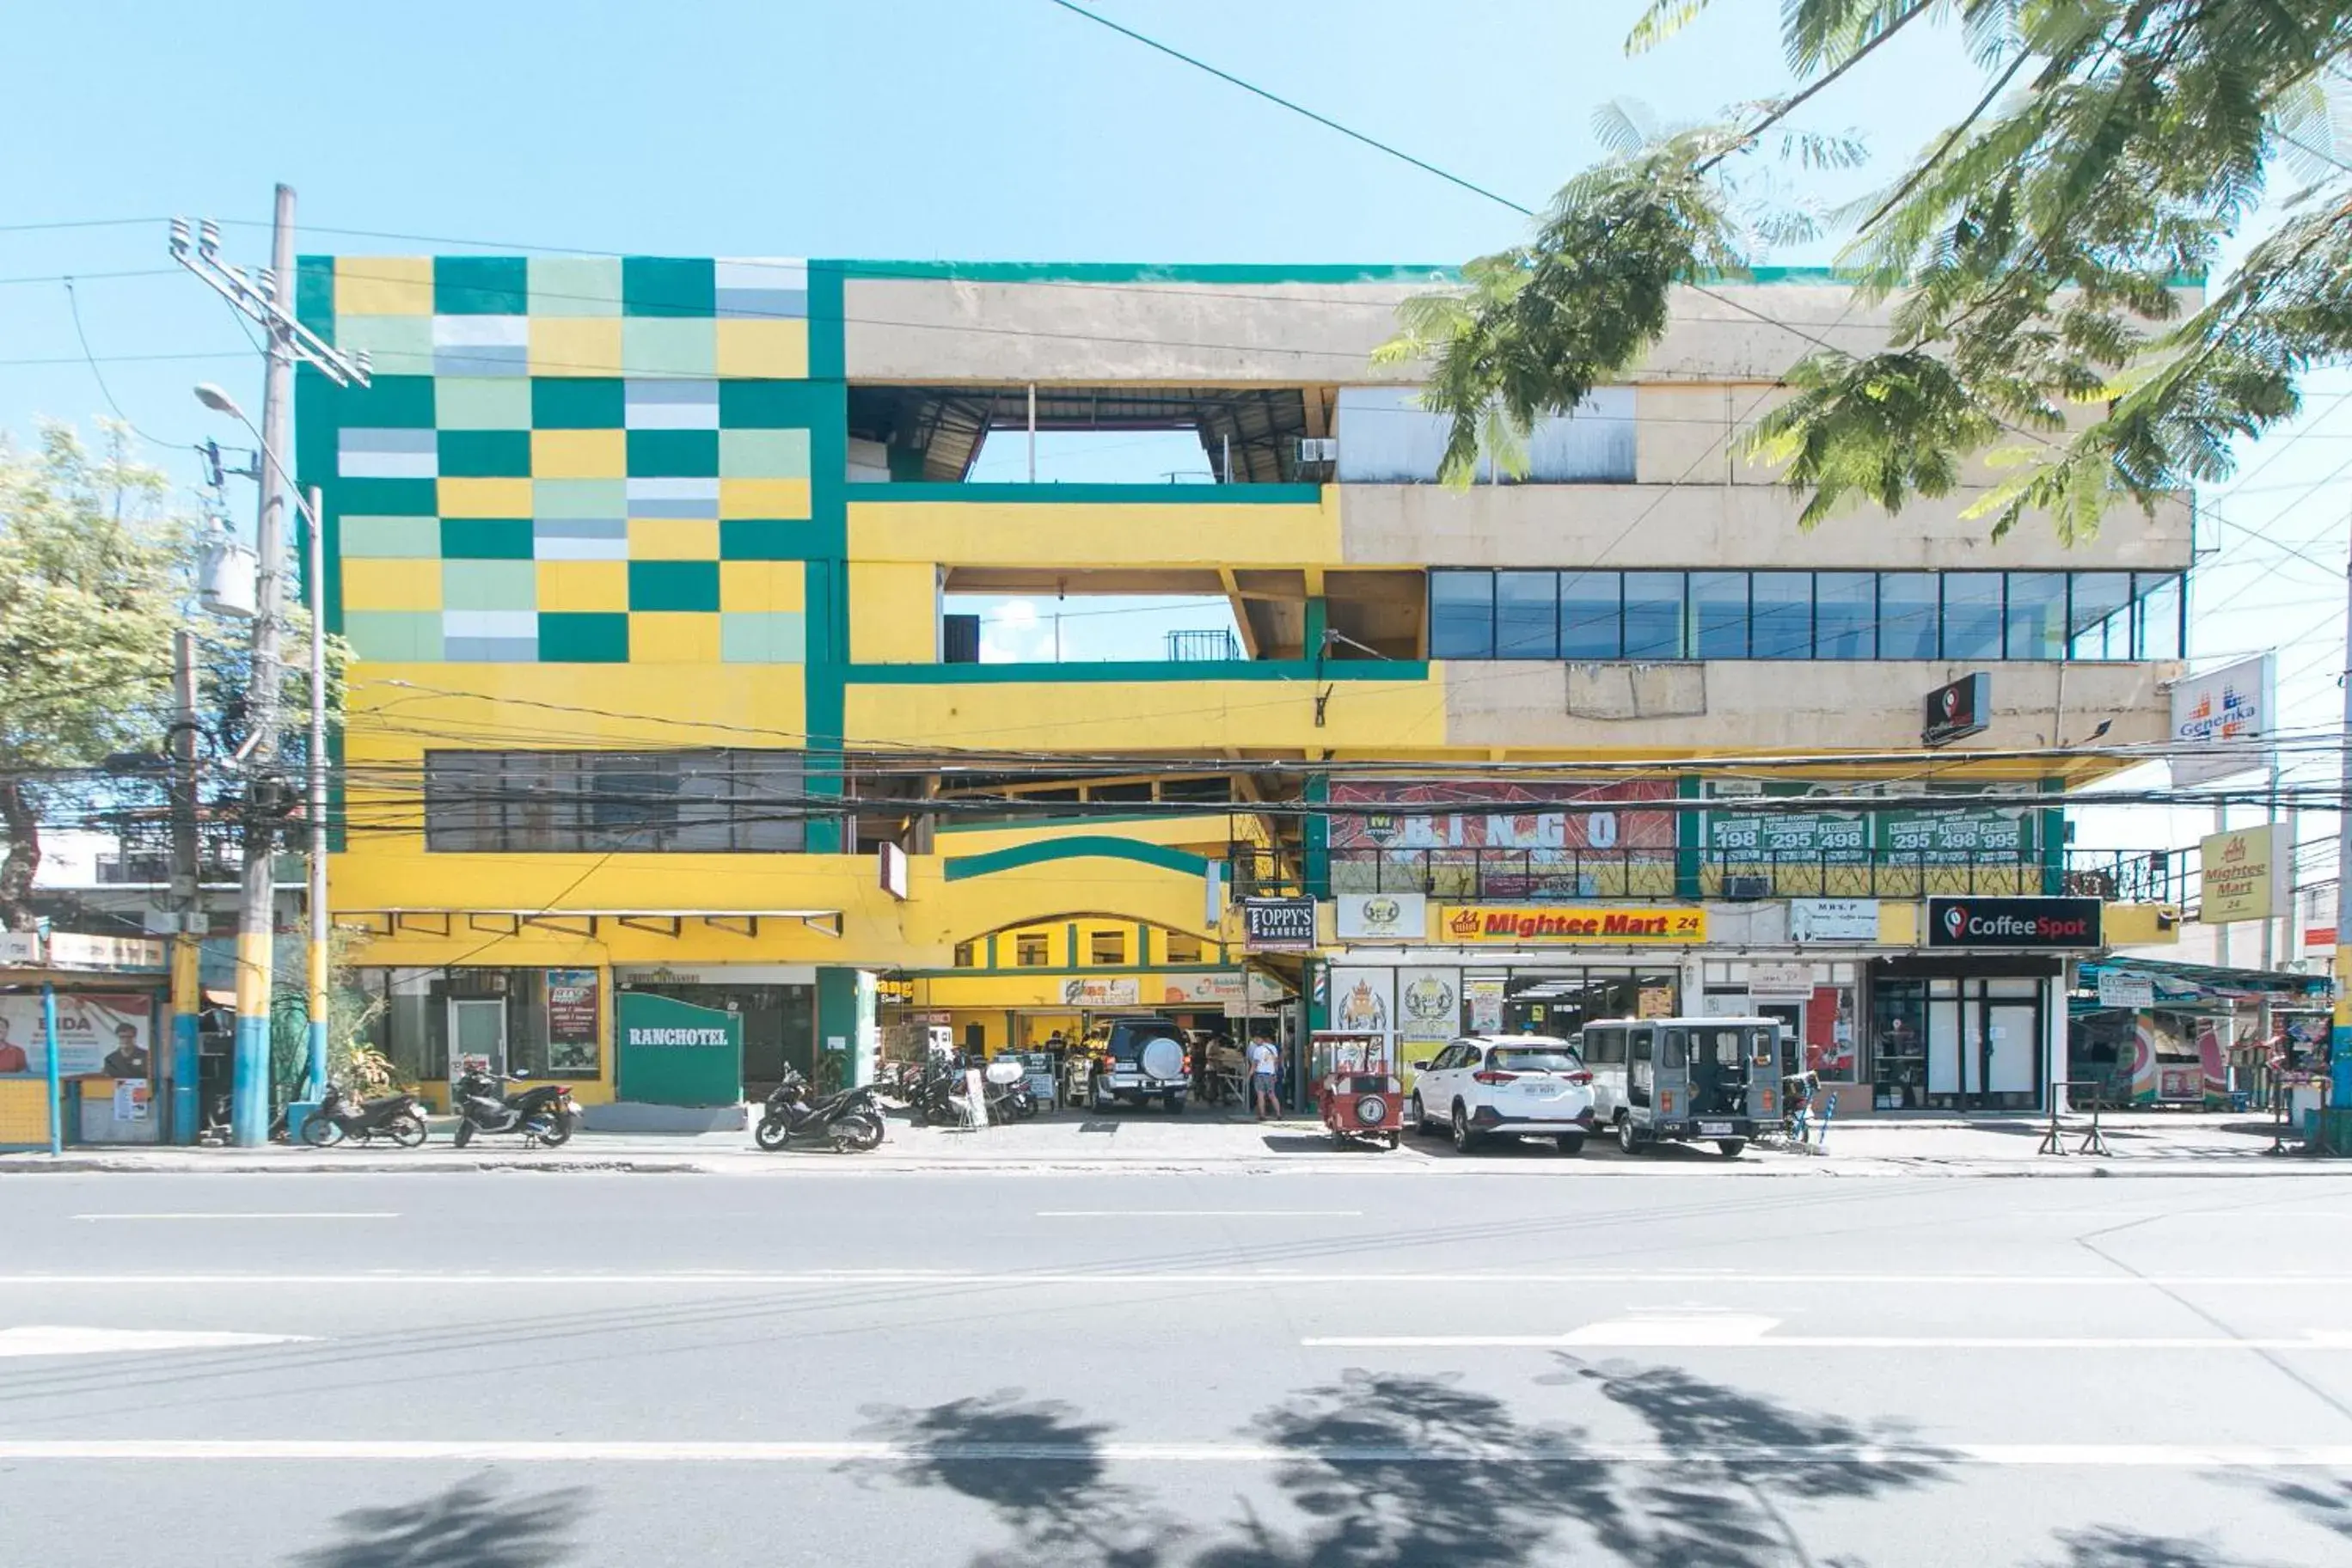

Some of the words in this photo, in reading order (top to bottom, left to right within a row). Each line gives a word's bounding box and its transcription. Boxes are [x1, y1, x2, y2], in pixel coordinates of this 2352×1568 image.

[2180, 706, 2256, 736] Generika
[1405, 812, 1617, 848] BINGO
[2204, 863, 2266, 880] Mightee
[1246, 907, 1312, 934] TOPPY'S
[1262, 927, 1312, 937] BARBERS
[1485, 914, 1598, 938] Mightee
[1602, 915, 1669, 934] Mart
[1677, 916, 1700, 929] 24
[628, 1027, 729, 1046] RANCHOTEL
